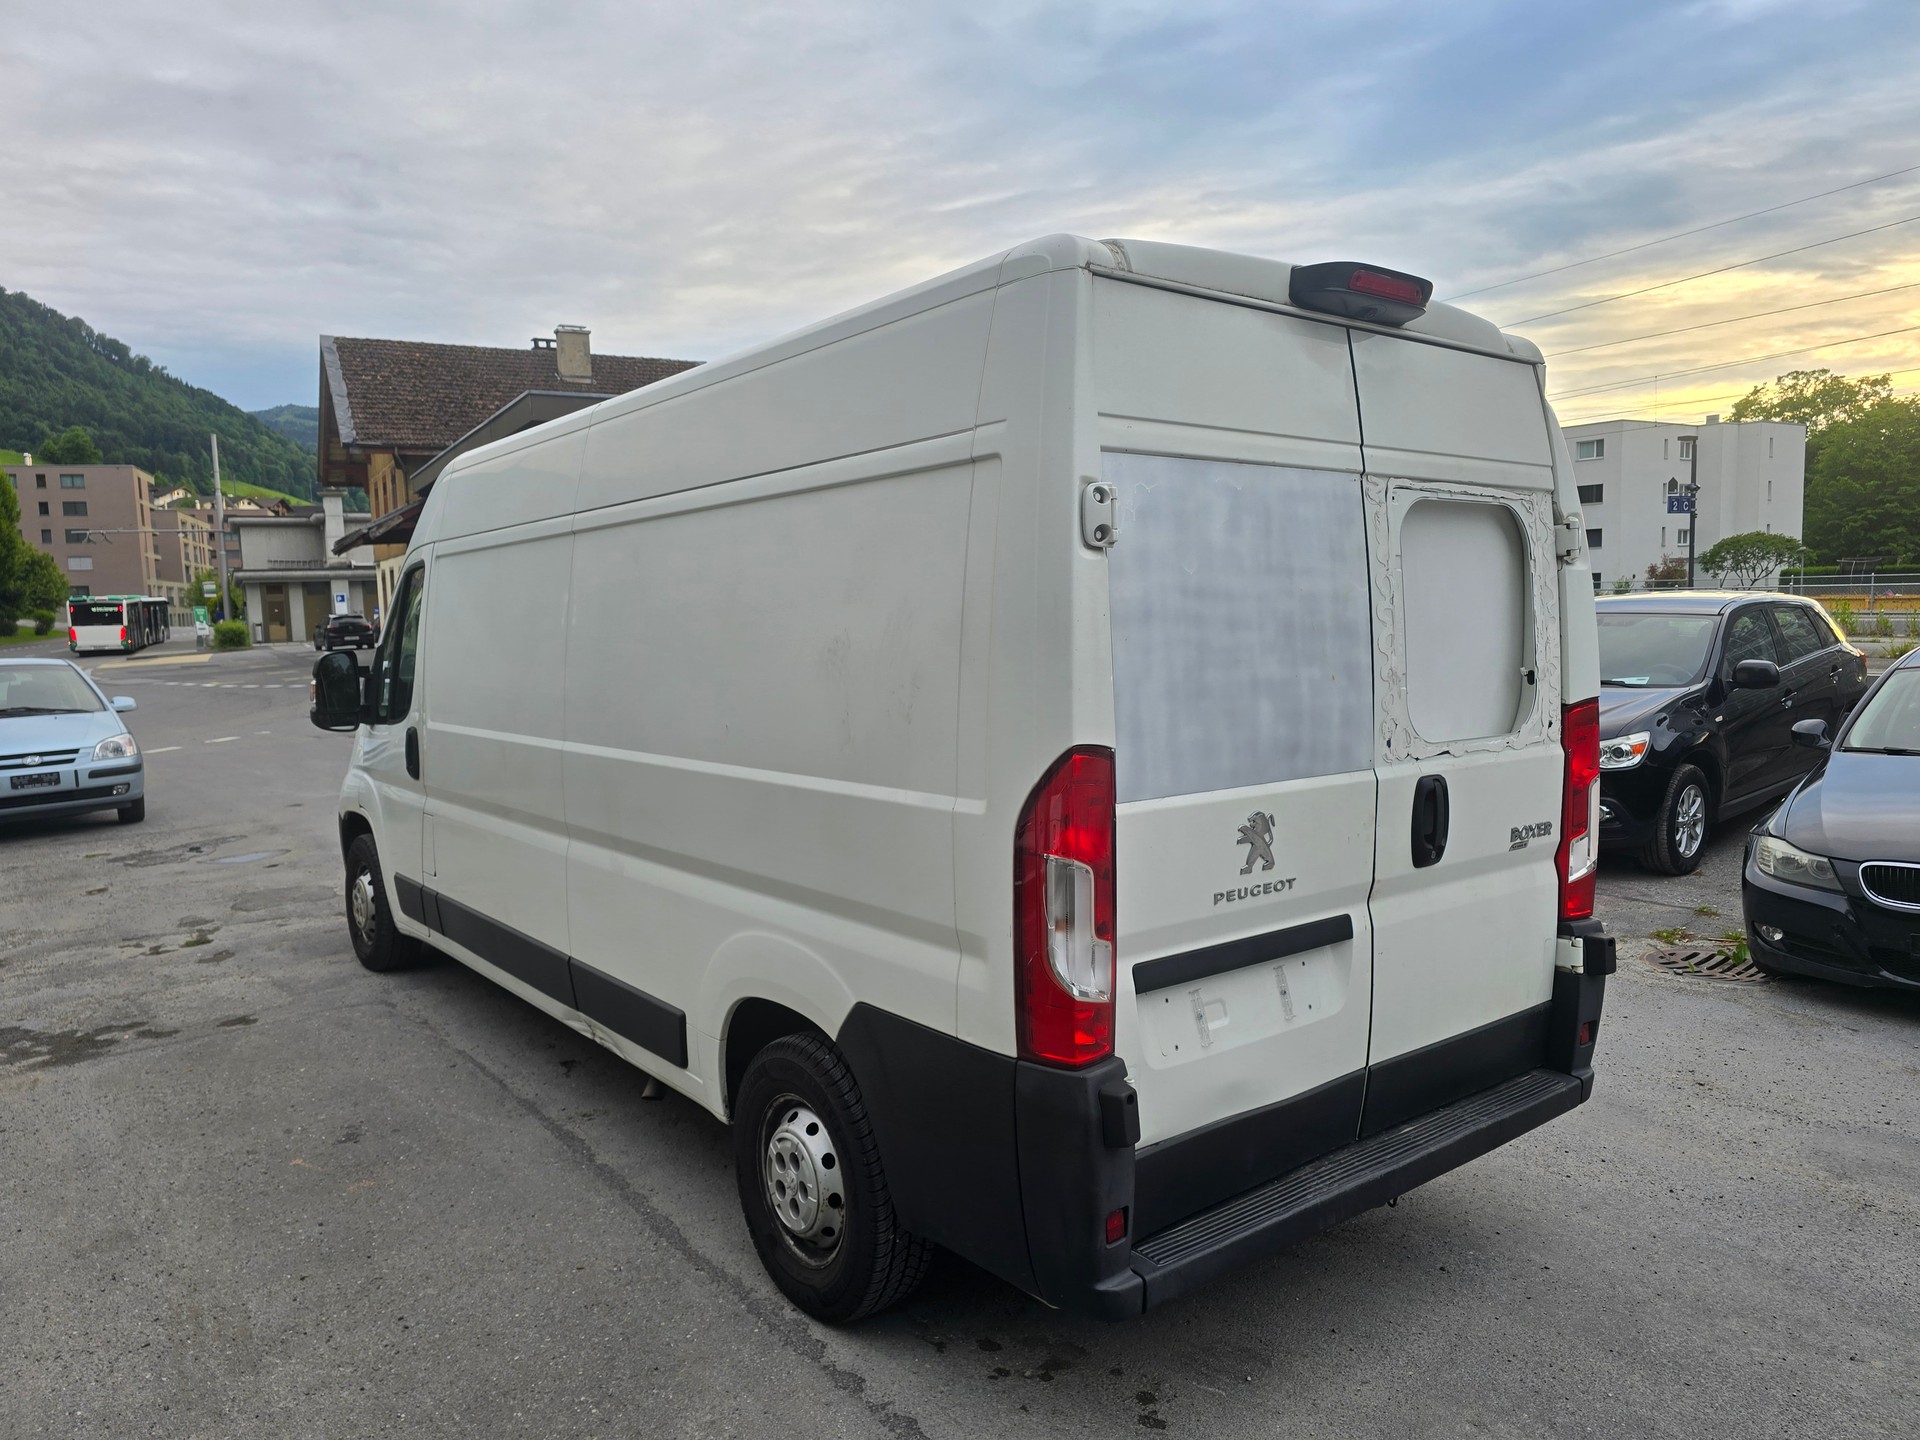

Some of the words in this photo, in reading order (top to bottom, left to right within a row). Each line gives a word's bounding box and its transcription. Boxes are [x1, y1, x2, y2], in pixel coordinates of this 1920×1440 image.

[1672, 501, 1678, 511] 2
[1683, 501, 1689, 511] C
[1510, 821, 1552, 843] BOXER
[1213, 877, 1297, 906] PEUGEOT
